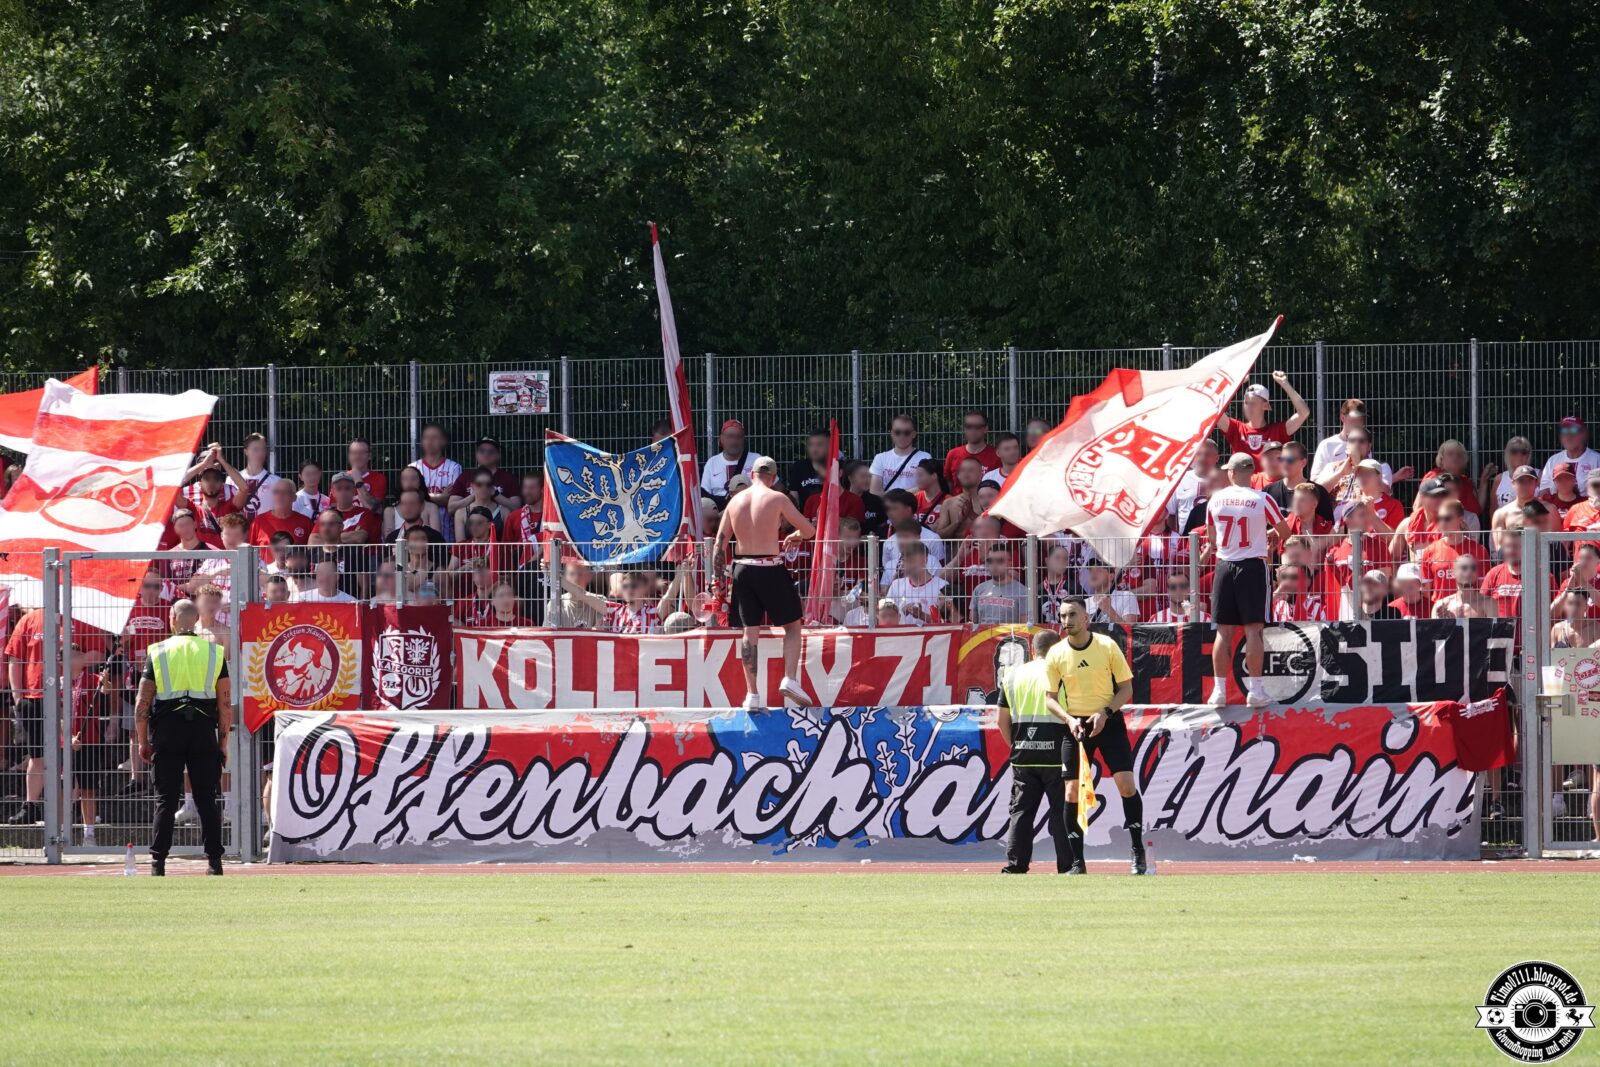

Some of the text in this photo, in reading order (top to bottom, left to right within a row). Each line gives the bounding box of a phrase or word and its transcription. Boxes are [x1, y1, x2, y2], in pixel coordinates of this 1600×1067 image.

[1217, 515, 1252, 549] 71
[378, 660, 433, 676] KATEGORIE
[874, 633, 953, 708] 71
[1320, 618, 1515, 704] SIDE
[274, 712, 883, 851] Offenbach
[1124, 713, 1478, 841] Main
